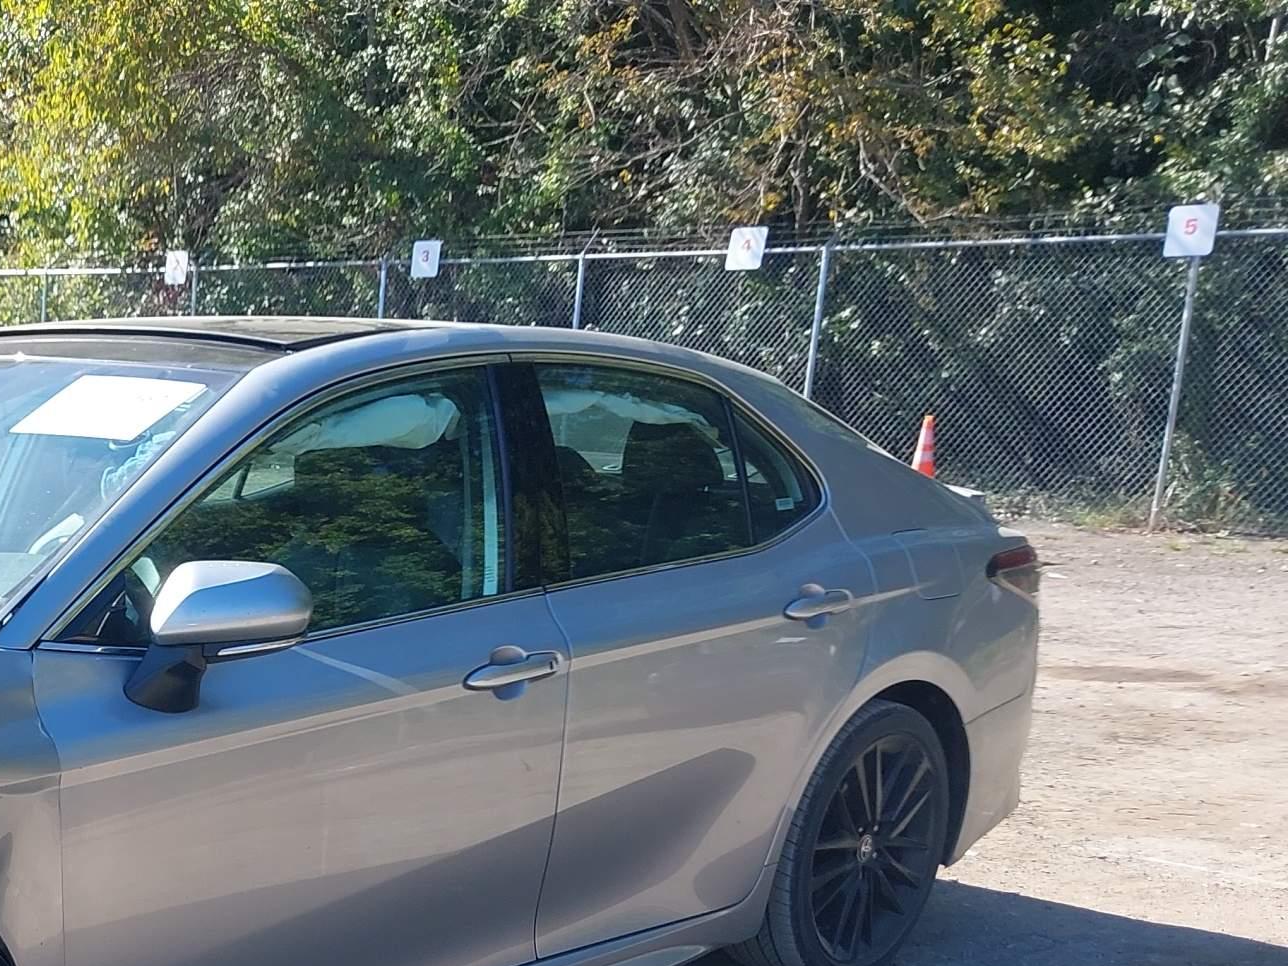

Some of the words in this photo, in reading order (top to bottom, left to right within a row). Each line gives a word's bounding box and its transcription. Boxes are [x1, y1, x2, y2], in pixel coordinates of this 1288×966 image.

[1184, 218, 1199, 235] 5
[742, 239, 752, 252] 4
[421, 249, 430, 263] 3
